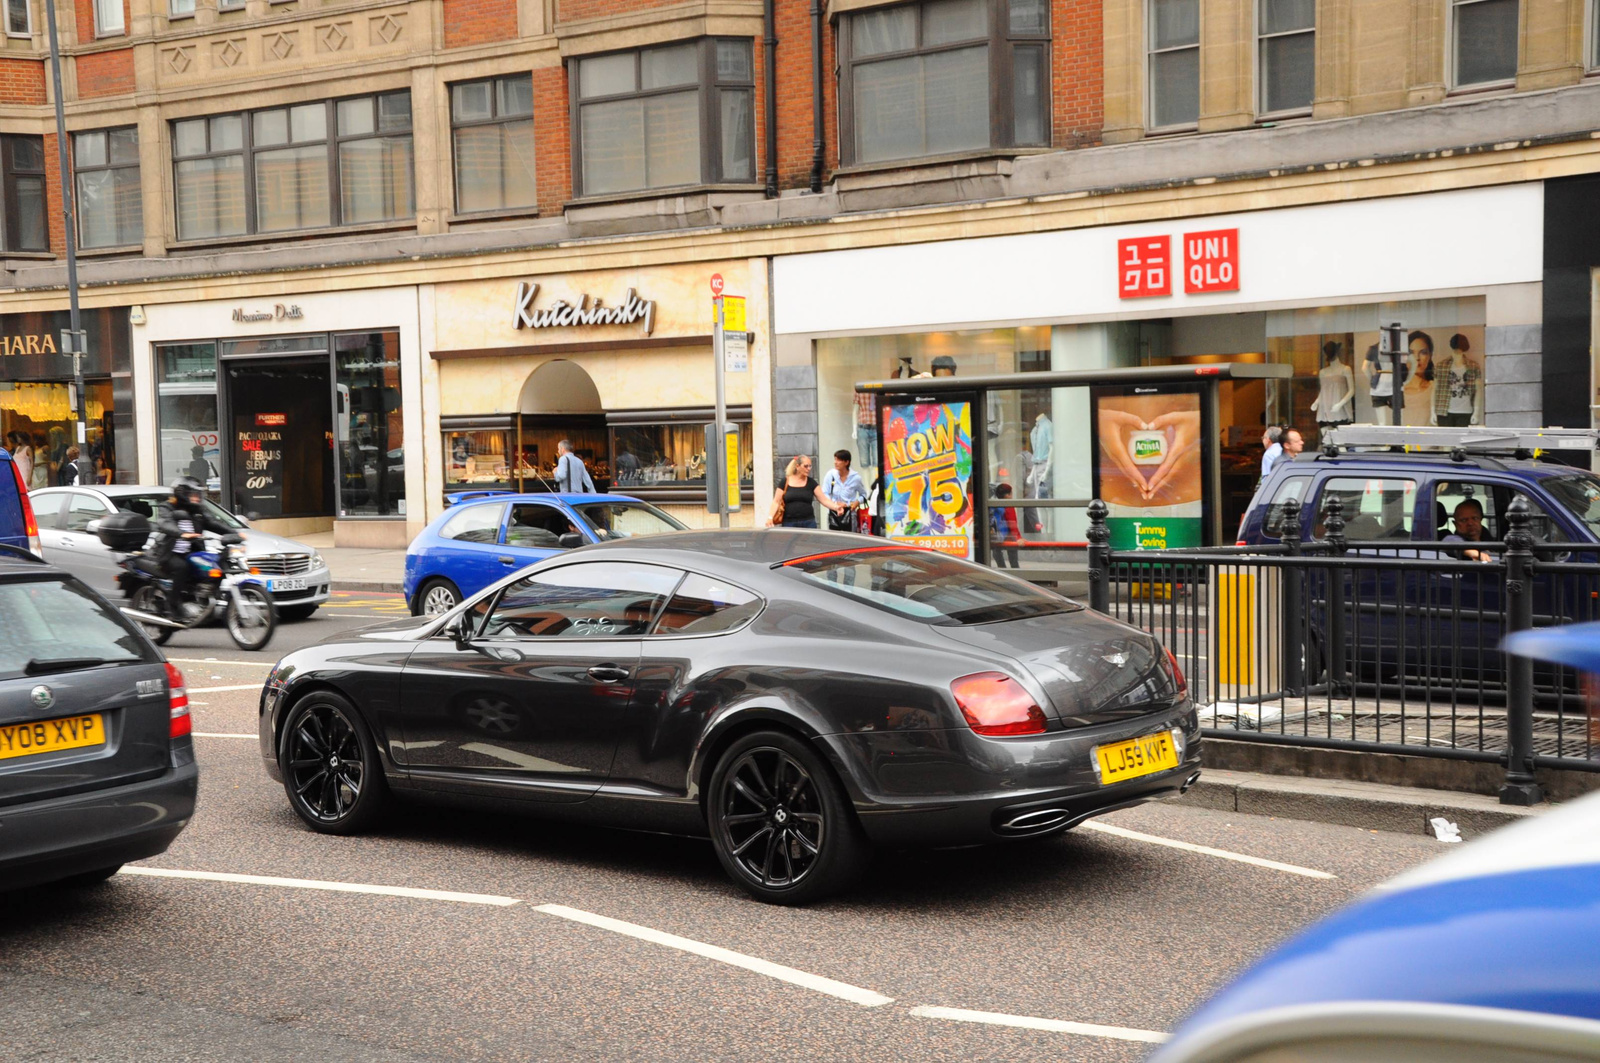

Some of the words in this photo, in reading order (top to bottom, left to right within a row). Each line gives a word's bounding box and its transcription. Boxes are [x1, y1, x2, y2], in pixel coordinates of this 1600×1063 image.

[1125, 243, 1163, 266] ユニ
[1189, 236, 1228, 260] UNI
[712, 278, 722, 289] KC
[1189, 261, 1233, 289] QLO
[512, 282, 656, 336] Kutchinsky
[242, 440, 262, 451] SALE
[886, 418, 955, 469] NOW
[250, 450, 281, 461] REBAJAS
[246, 476, 273, 489] 60%
[895, 467, 963, 521] 75
[1133, 522, 1166, 537] Tummy
[919, 539, 964, 549] 29.03.10
[1136, 534, 1166, 549] Loving
[0, 724, 46, 750] Y08
[52, 717, 94, 743] XVP
[1104, 746, 1143, 774] LJ59
[1144, 739, 1168, 764] KVF
